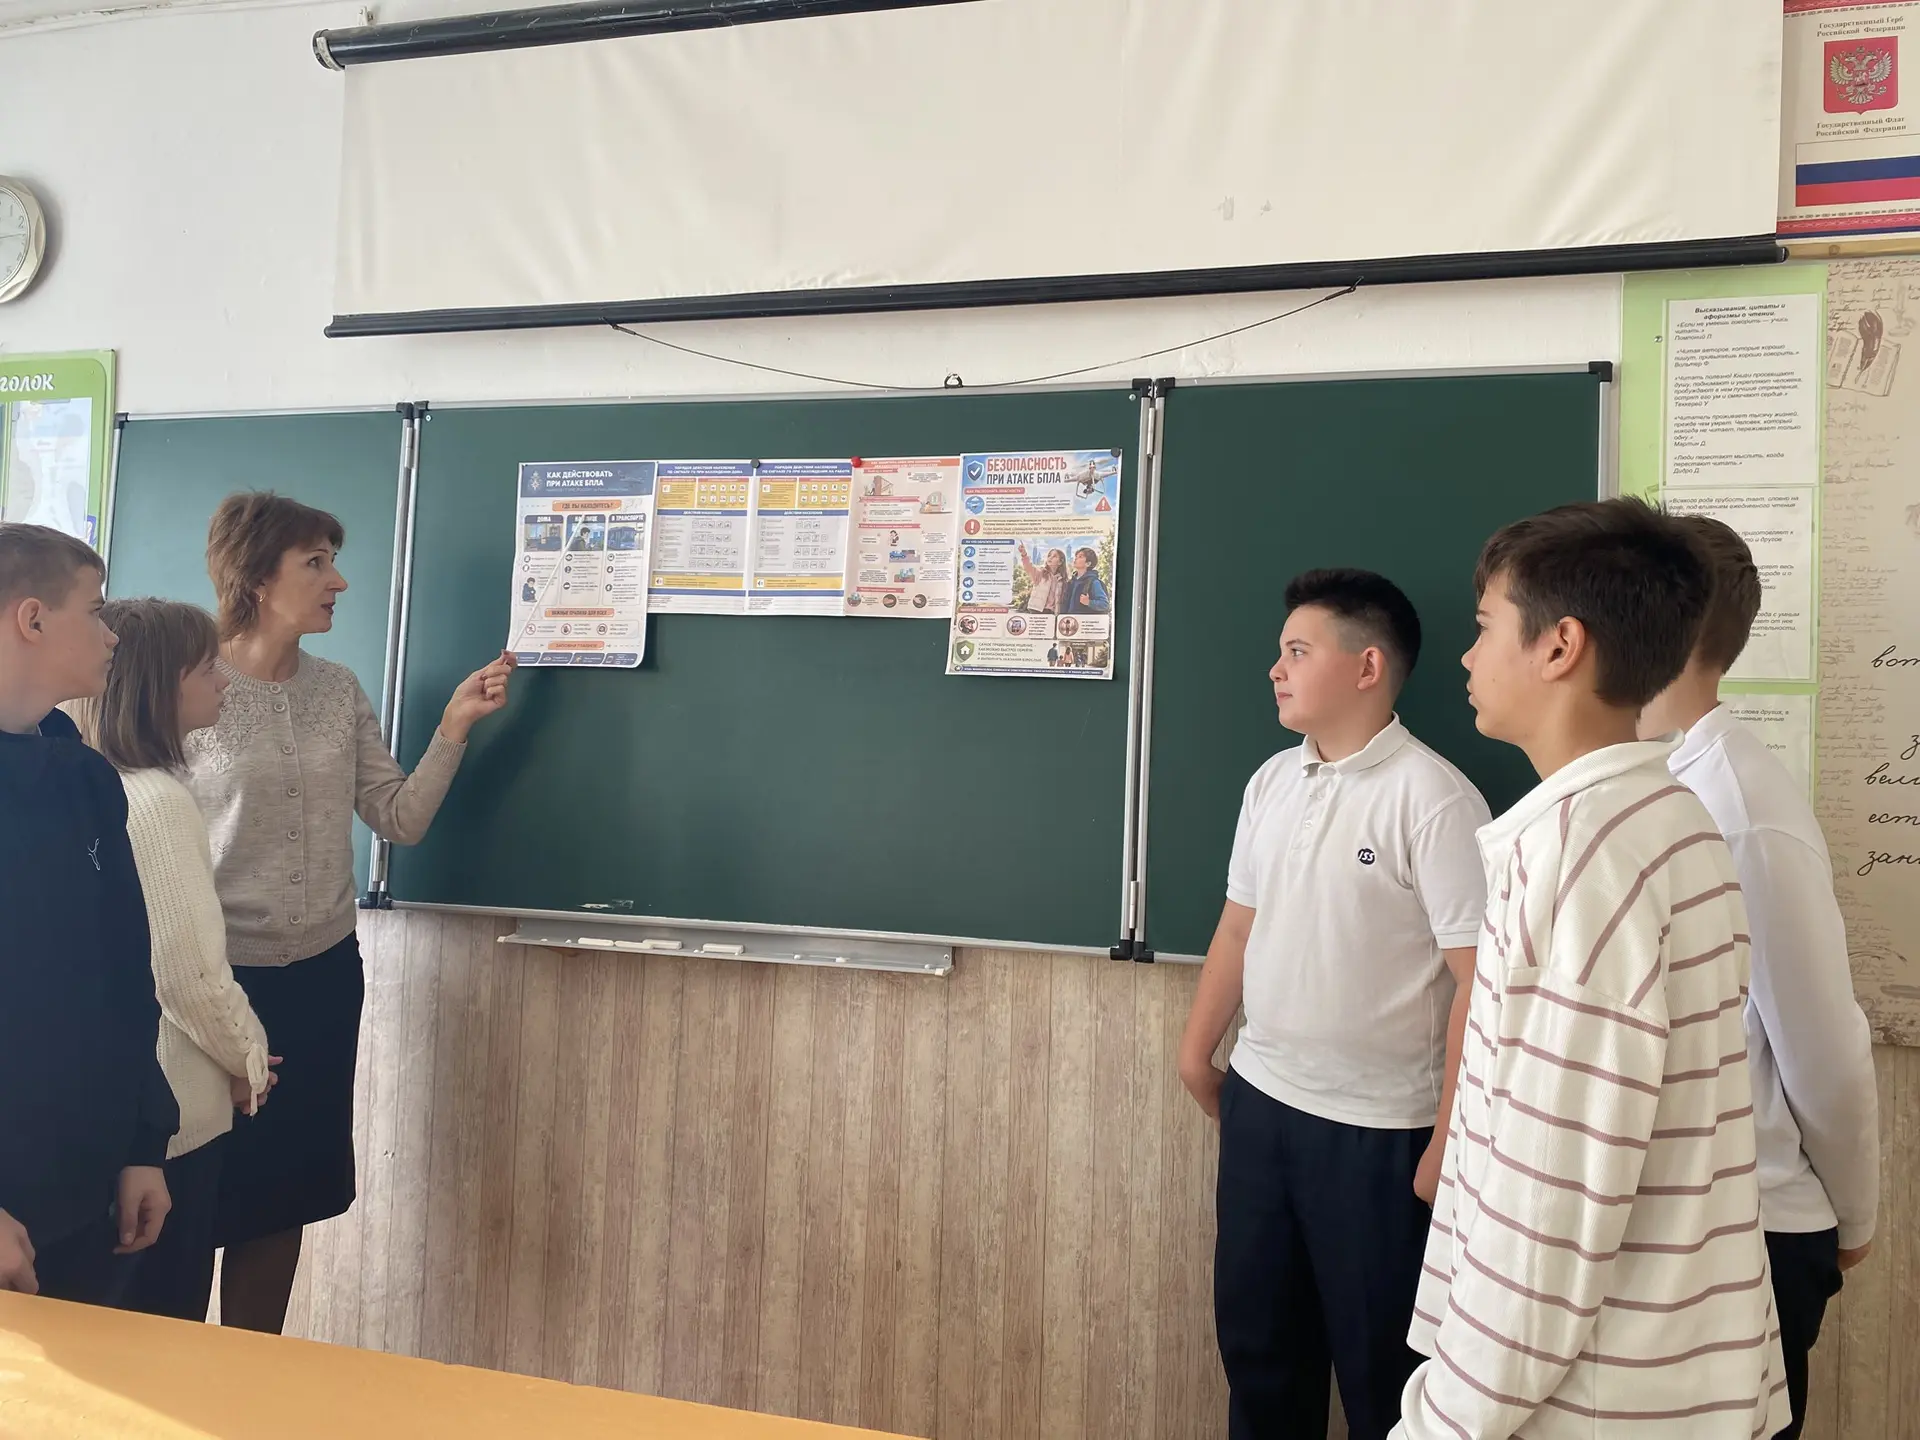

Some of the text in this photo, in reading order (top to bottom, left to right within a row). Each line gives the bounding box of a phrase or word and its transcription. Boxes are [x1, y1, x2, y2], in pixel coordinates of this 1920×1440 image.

[1820, 18, 1884, 28] Государственный
[1817, 28, 1859, 37] Российской
[1817, 119, 1883, 129] Государственный
[987, 457, 1067, 472] БЕЗОПАСНОСТЬ
[562, 470, 613, 478] ДЕЙСТВОВАТЬ
[987, 472, 1061, 484] ПРИ АТАКЕ БПЛА
[1359, 851, 1374, 861] ISS
